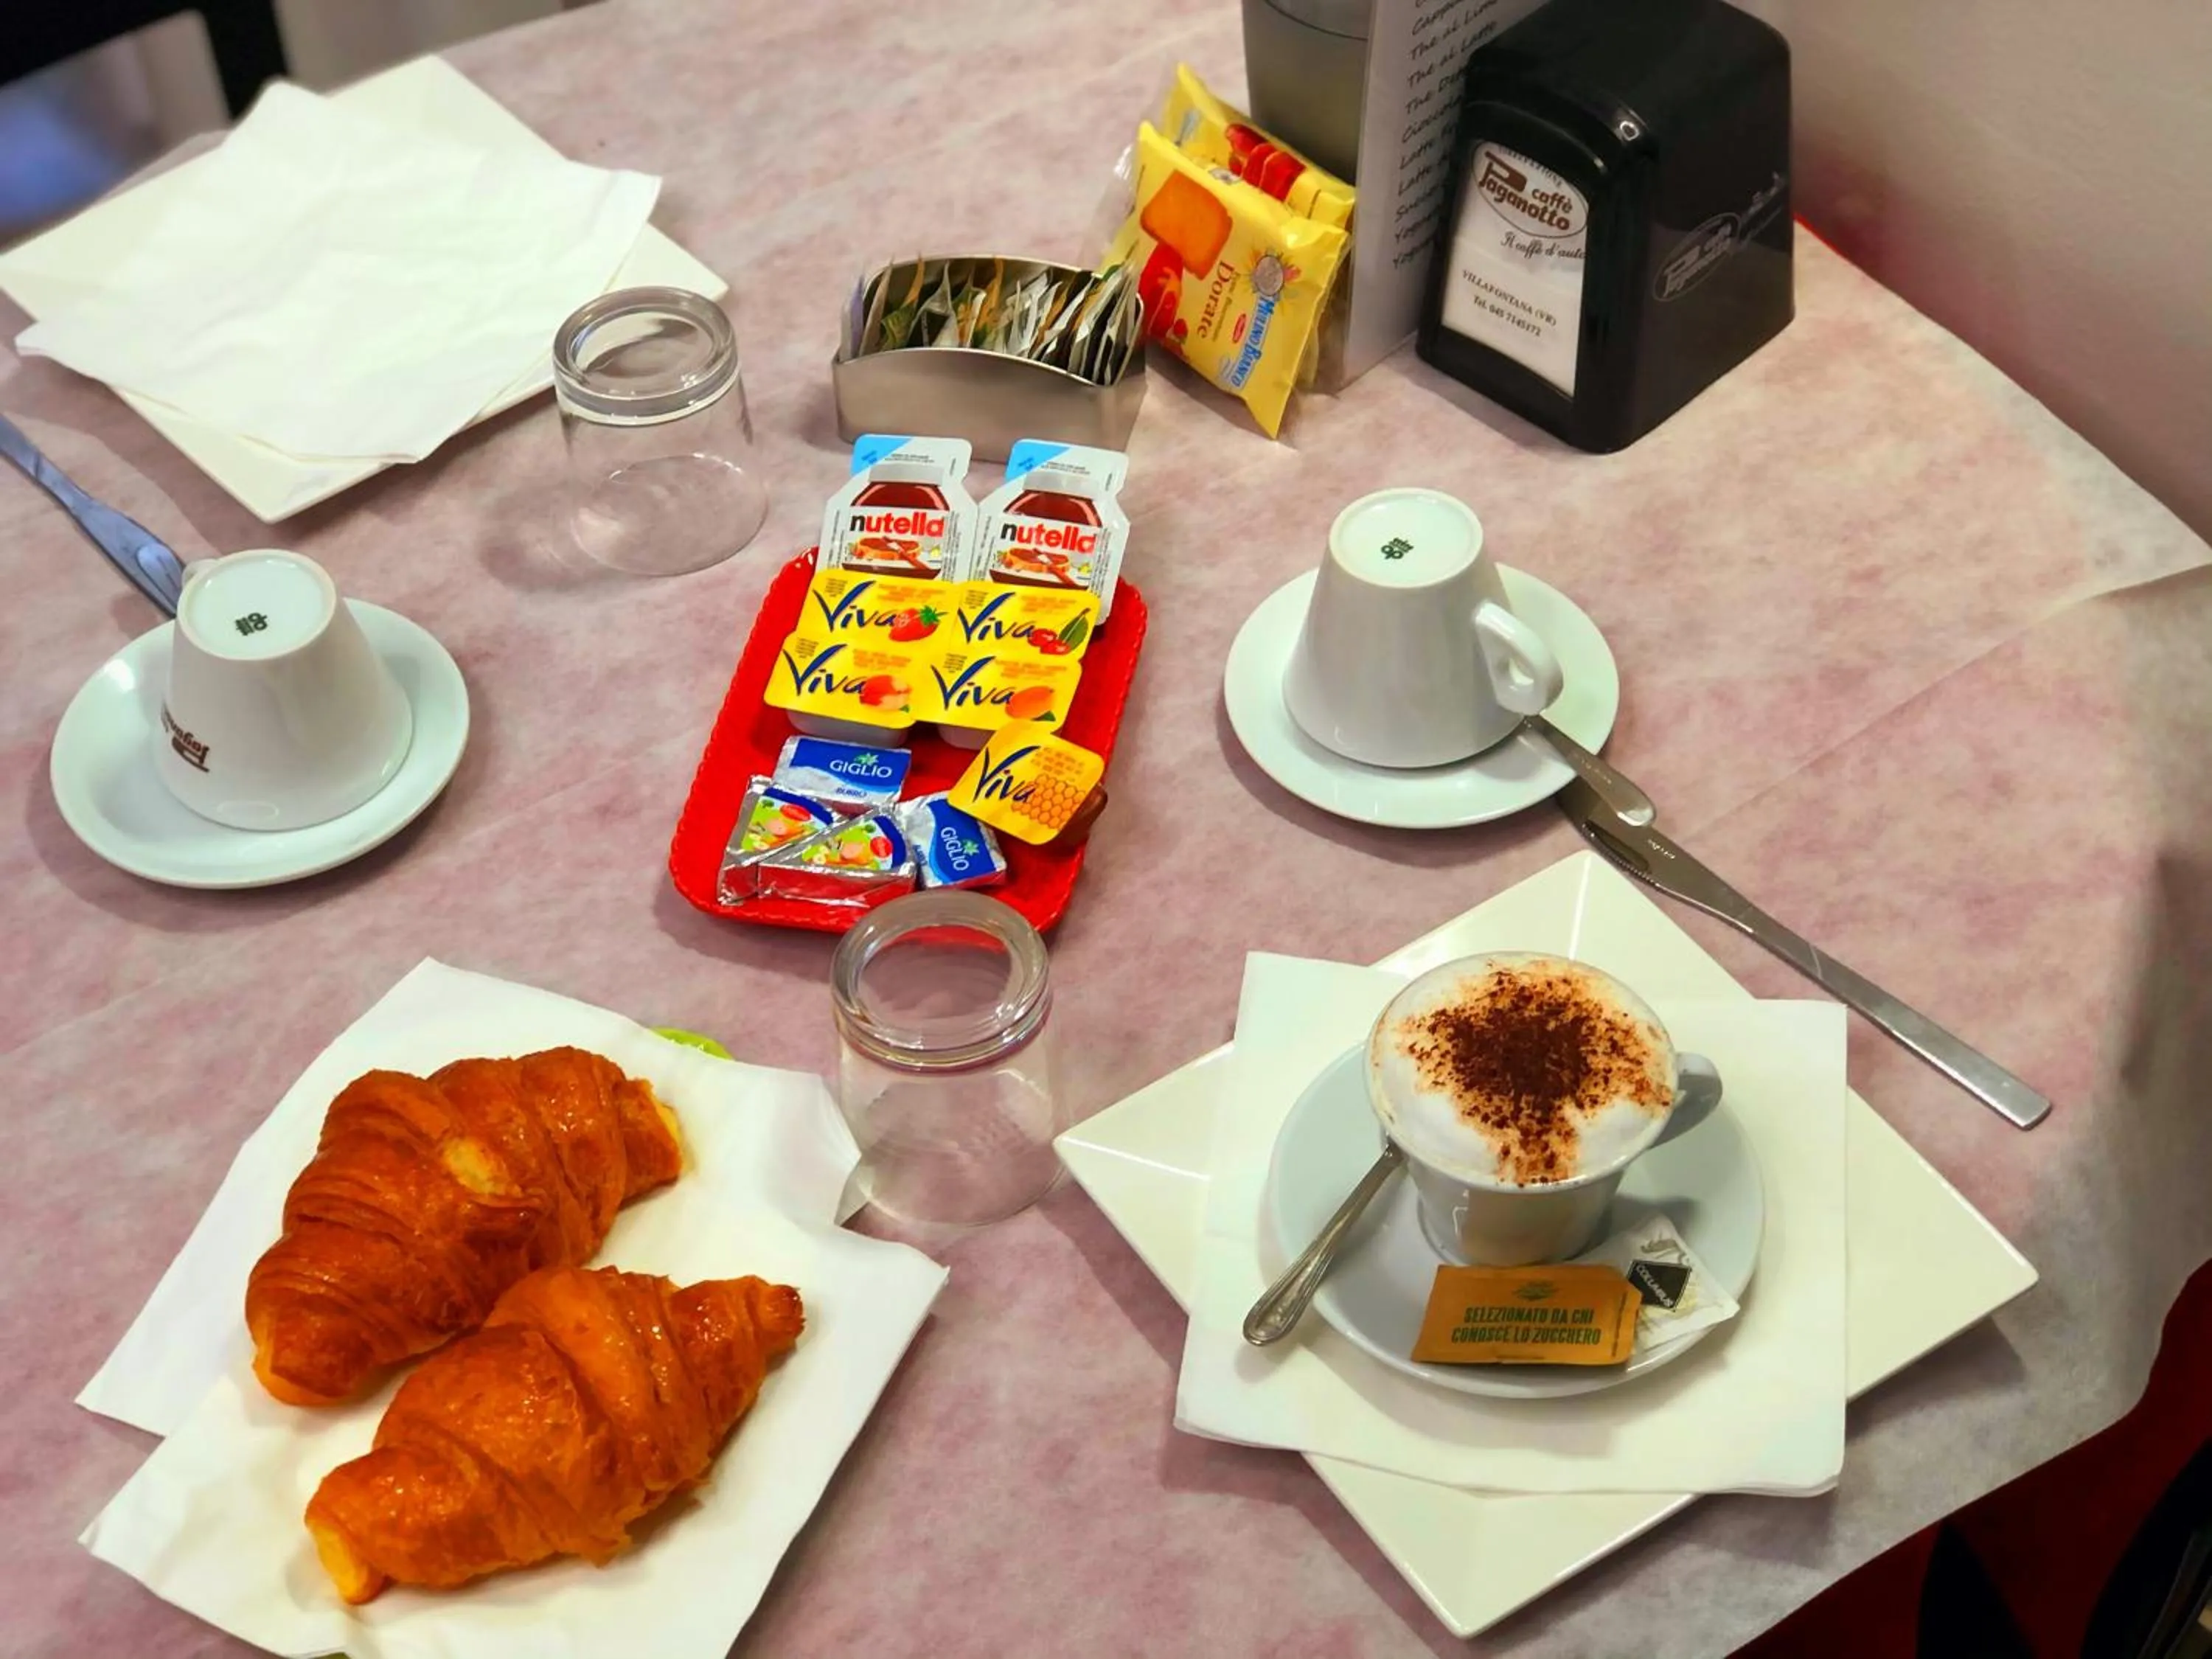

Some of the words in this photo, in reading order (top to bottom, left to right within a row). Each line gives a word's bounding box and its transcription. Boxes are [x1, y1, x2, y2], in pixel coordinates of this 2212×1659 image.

[1478, 150, 1571, 231] Paganotto
[1531, 188, 1573, 214] caffè
[1197, 261, 1235, 339] Dorate
[1462, 269, 1533, 314] VILLAFONTANA
[1489, 304, 1505, 318] 045
[849, 511, 945, 538] nutella
[1000, 522, 1097, 554] nutella
[812, 580, 898, 633] Viva
[957, 591, 1036, 644] Viva
[782, 643, 868, 697] Viva
[931, 655, 1017, 711] Viva
[830, 759, 893, 779] GIGLIO
[972, 745, 1041, 803] Viva
[940, 827, 970, 872] GIGLIO
[1450, 1327, 1512, 1345] CONOSCE
[1513, 1327, 1531, 1344] LO
[1532, 1328, 1602, 1346] ZUCCHERO
[1464, 1306, 1548, 1324] SELEZIONATO
[1550, 1307, 1568, 1324] DA
[1571, 1308, 1595, 1325] CHI
